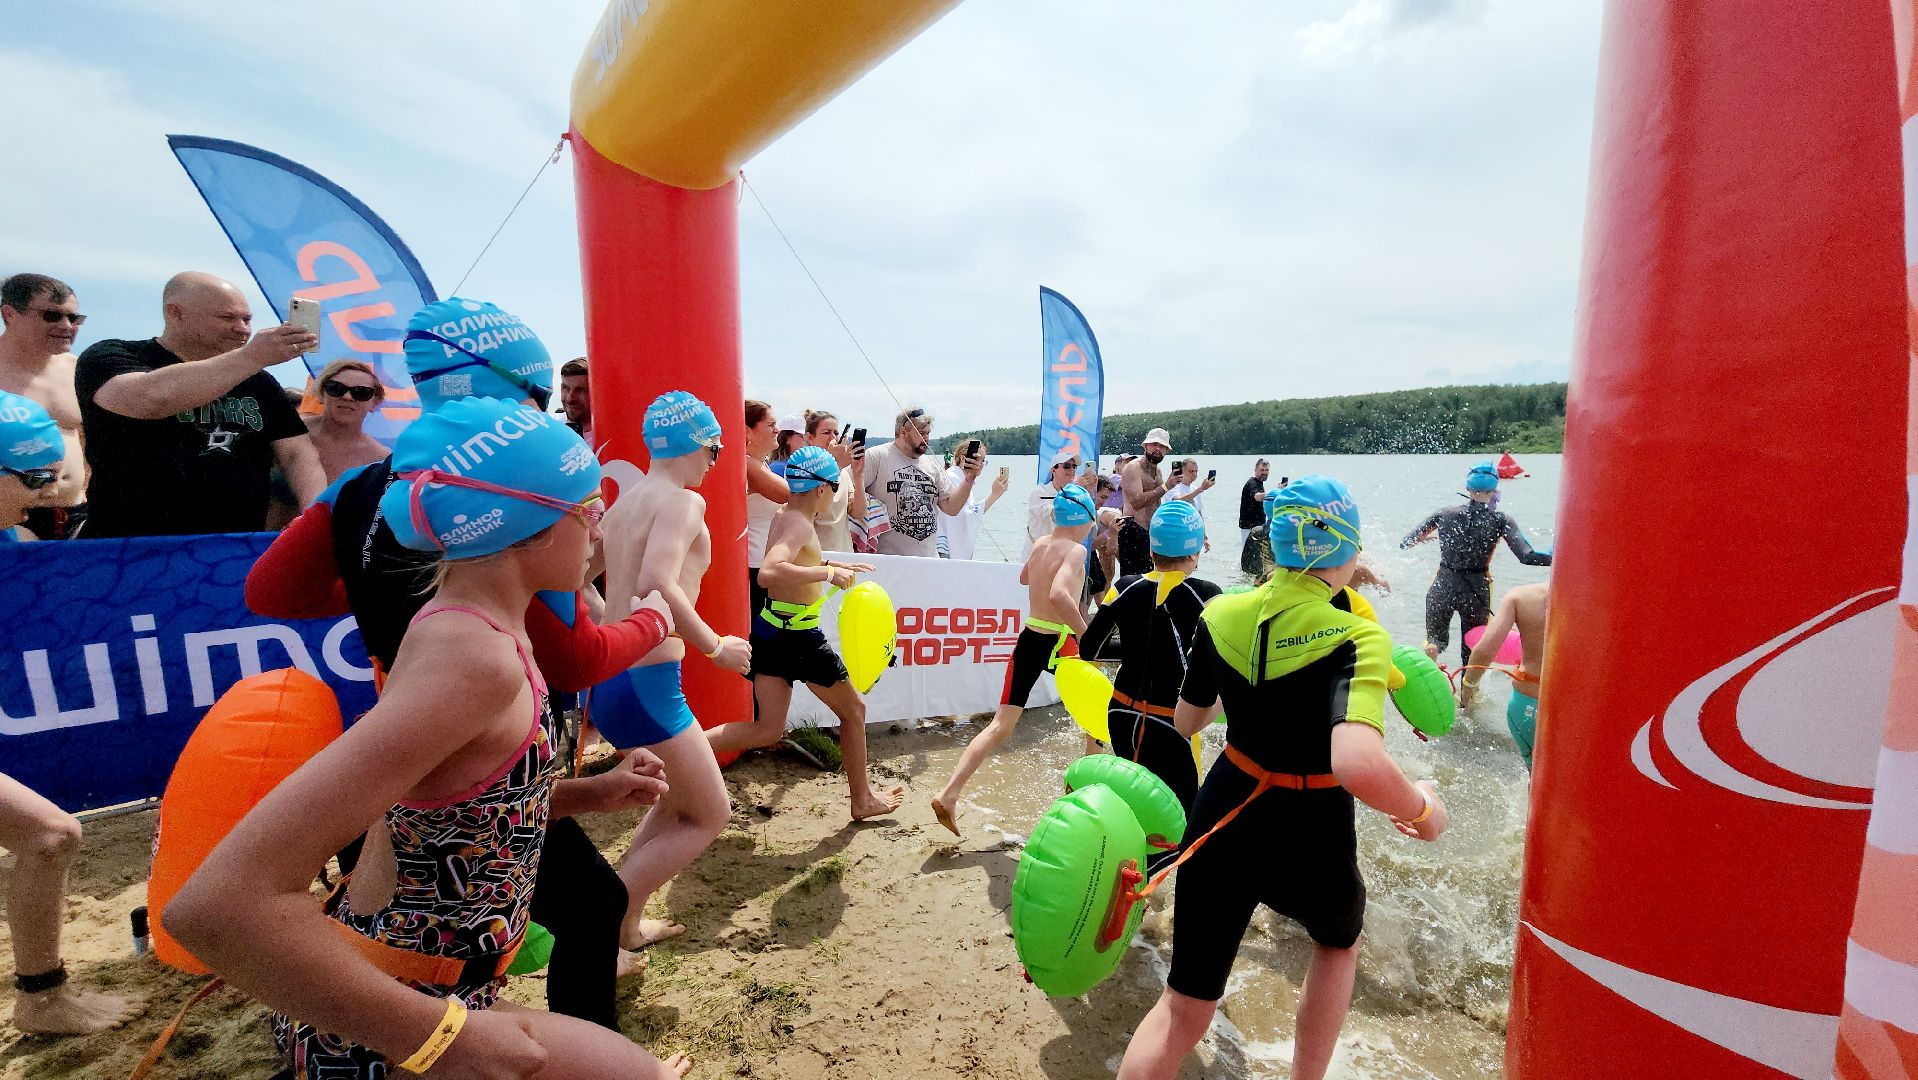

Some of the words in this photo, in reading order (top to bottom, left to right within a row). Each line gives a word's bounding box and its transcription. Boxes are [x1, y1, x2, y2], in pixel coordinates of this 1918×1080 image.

[654, 404, 704, 429] РОДНИК
[409, 408, 550, 496] wimcup
[896, 607, 1021, 635] ОСОБЛ
[896, 637, 990, 667] ПОРТ
[0, 613, 375, 736] wimc
